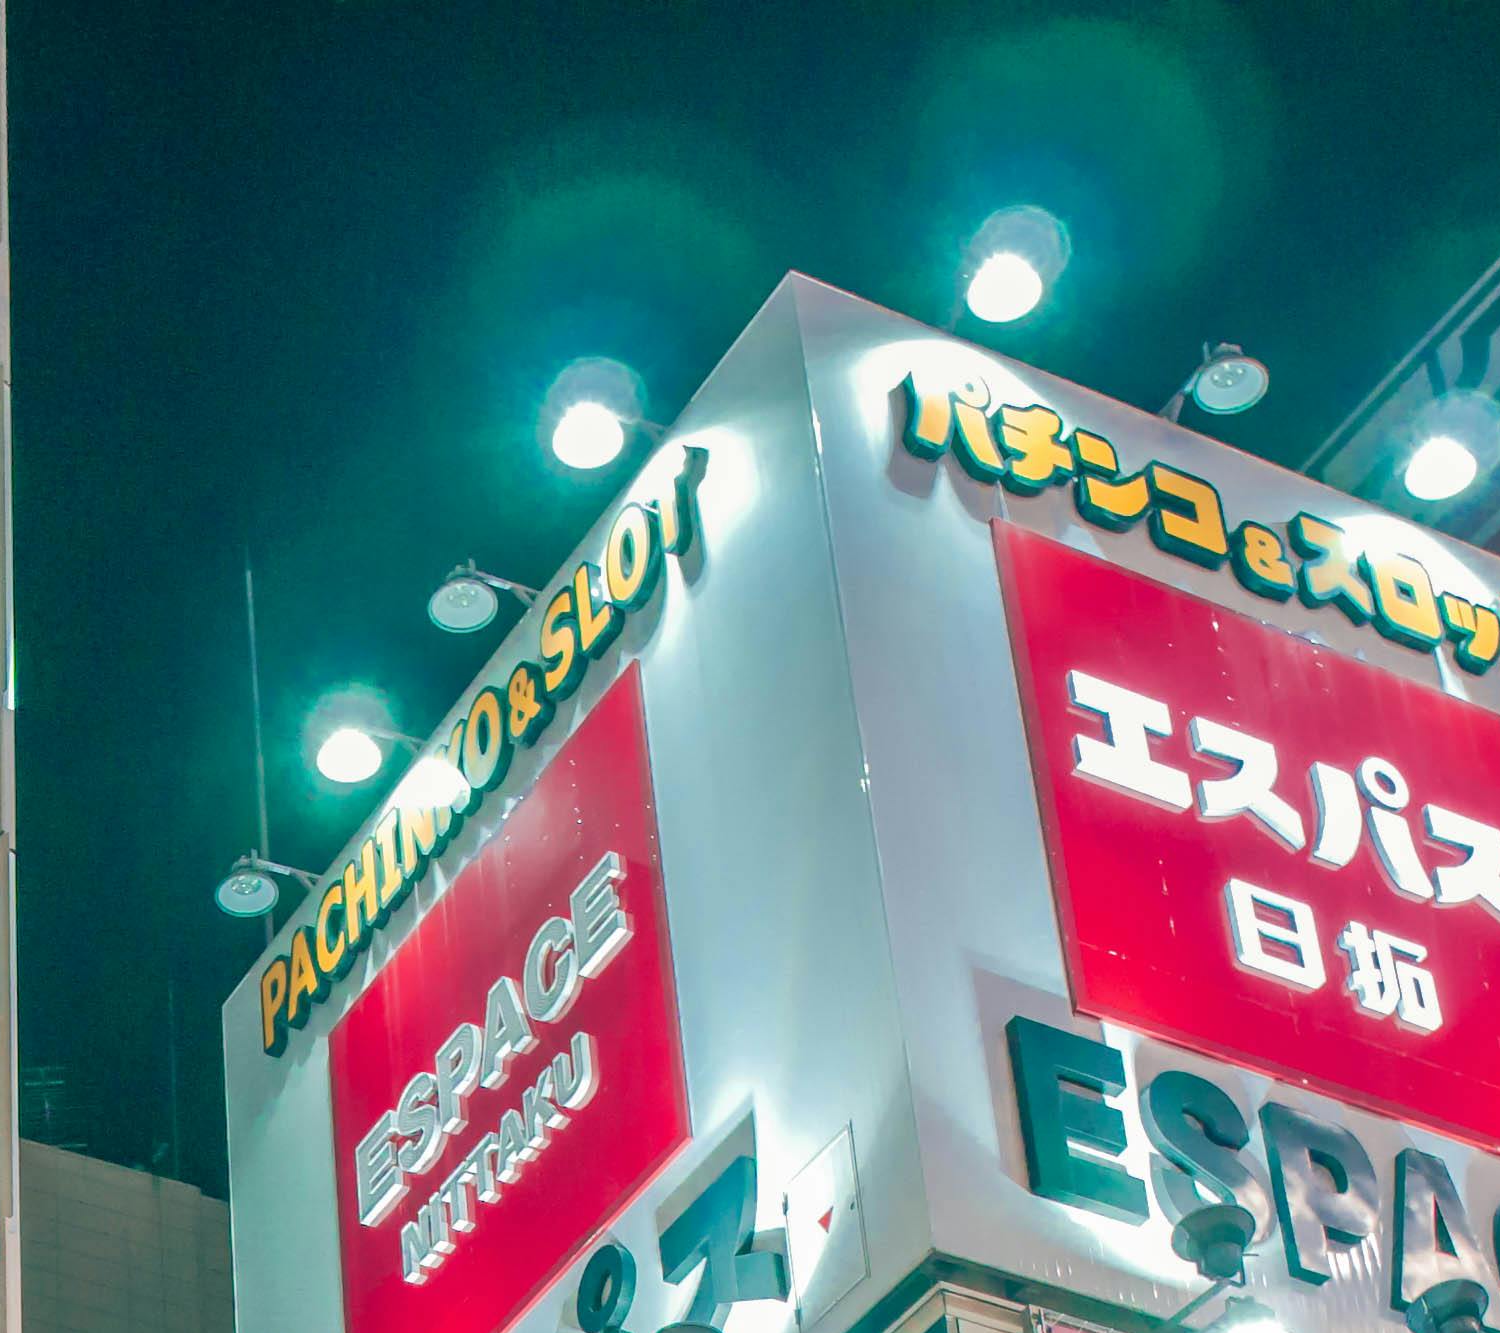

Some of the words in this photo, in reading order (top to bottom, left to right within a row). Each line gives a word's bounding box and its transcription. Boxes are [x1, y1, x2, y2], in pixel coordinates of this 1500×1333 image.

[261, 684, 503, 1056] PACHINO
[506, 659, 554, 746] &
[354, 850, 636, 1230] ESPACE
[400, 1031, 601, 1286] NITTAKU
